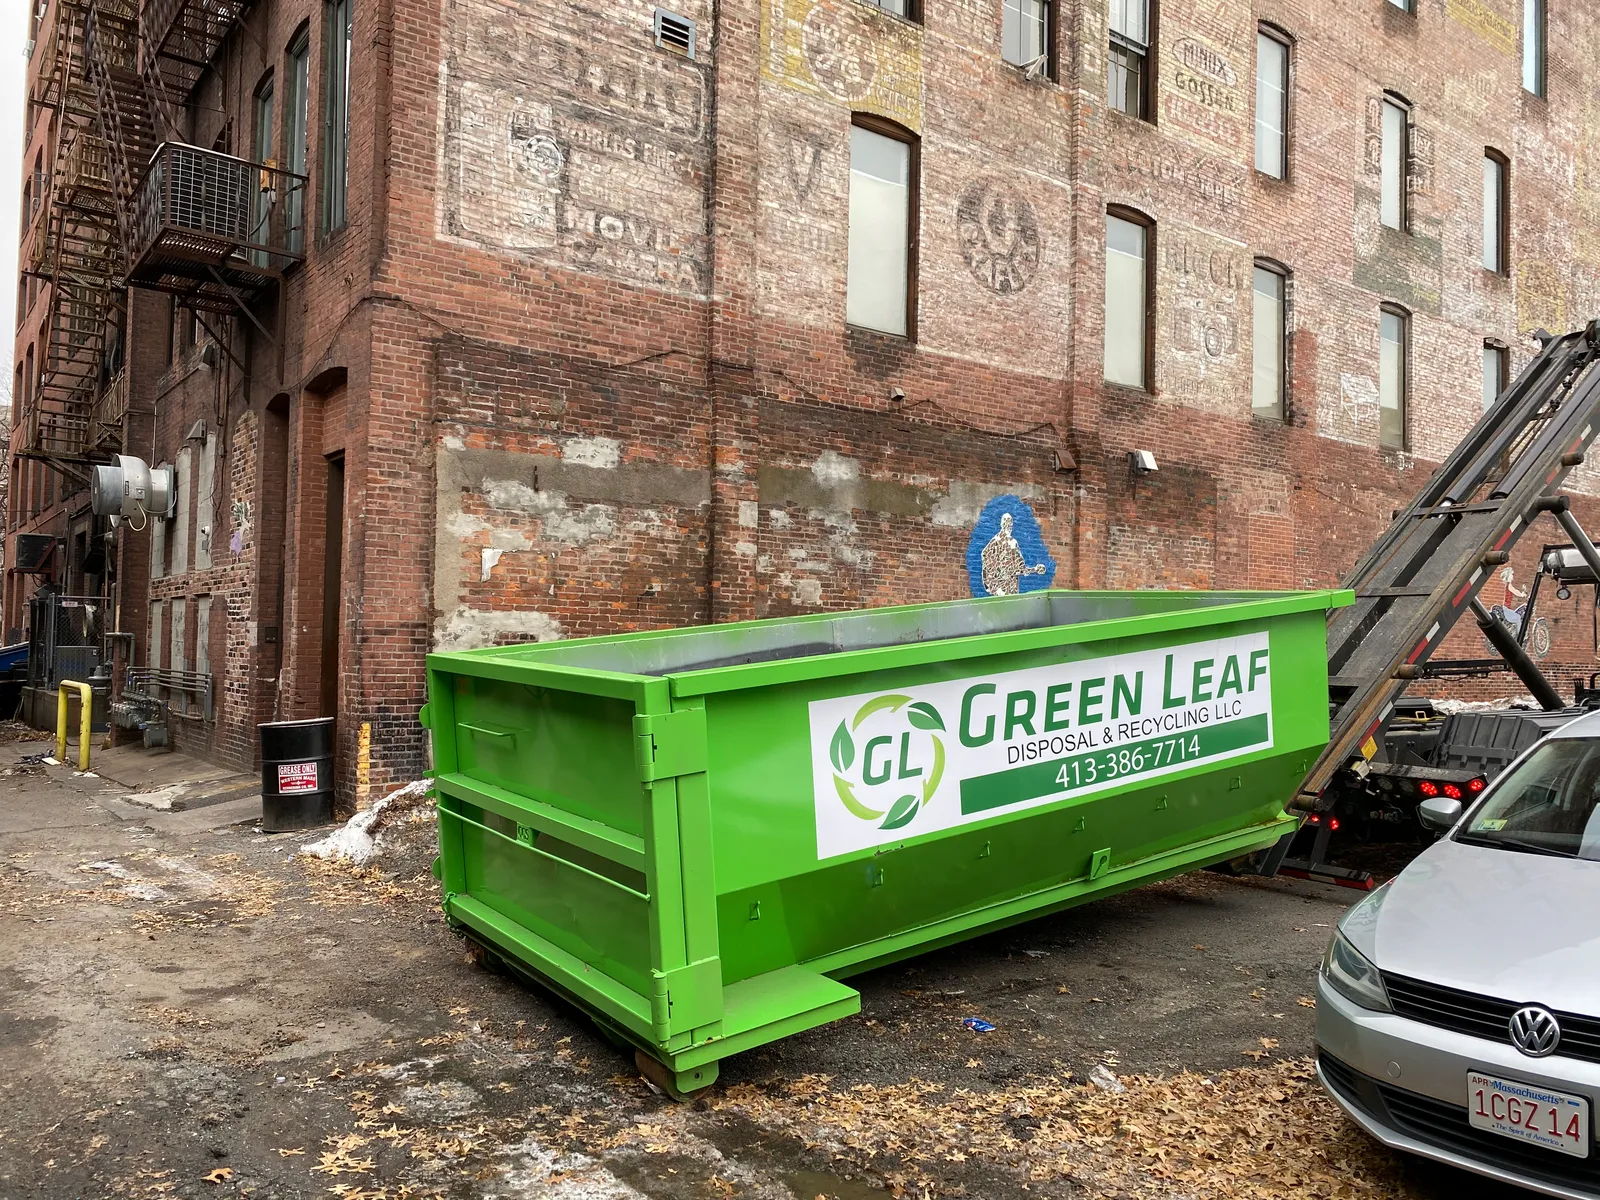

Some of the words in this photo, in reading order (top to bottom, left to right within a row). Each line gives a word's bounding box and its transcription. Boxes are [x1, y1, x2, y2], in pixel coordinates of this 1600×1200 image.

[958, 670, 1144, 749] GREEN
[1163, 648, 1269, 710] LEAF
[862, 731, 923, 786] GL
[1006, 730, 1099, 765] DISPOSAL
[1102, 727, 1114, 744] &
[1118, 707, 1211, 741] RECYCLING
[1215, 699, 1242, 720] LLC
[280, 765, 301, 775] GREASE
[302, 764, 316, 774] ONLY
[1055, 734, 1201, 789] 413-386-7714
[1471, 1076, 1489, 1087] APR
[1493, 1080, 1560, 1106] Massachusetts
[1475, 1088, 1539, 1132] 1CGZ
[1548, 1107, 1581, 1142] 14
[1496, 1122, 1508, 1131] The
[1508, 1126, 1525, 1138] Spirit
[1526, 1131, 1532, 1139] of
[1533, 1133, 1560, 1146] America
